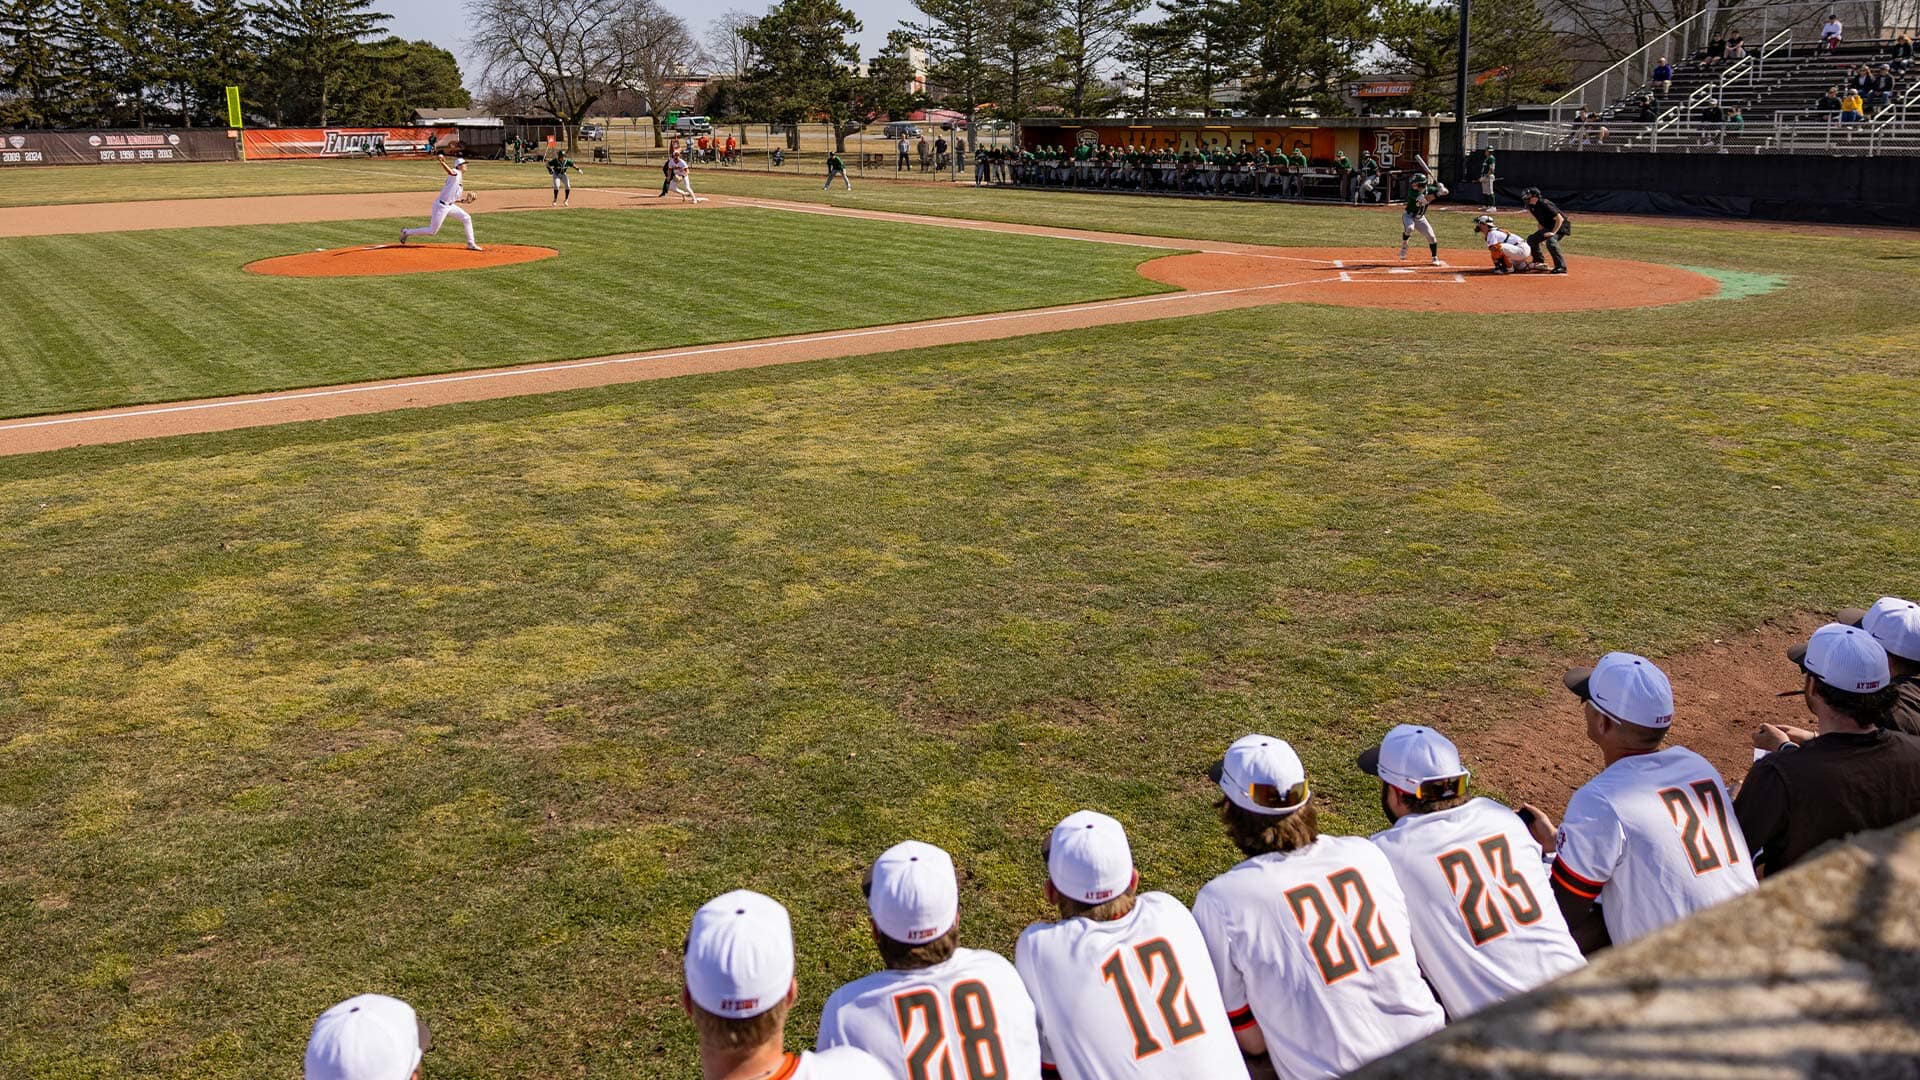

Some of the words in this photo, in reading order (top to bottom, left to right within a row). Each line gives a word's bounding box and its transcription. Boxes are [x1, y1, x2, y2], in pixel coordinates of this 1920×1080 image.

[100, 150, 116, 160] 1972
[1657, 778, 1740, 876] 27
[1283, 867, 1400, 985] 22
[1436, 833, 1544, 946] 23
[893, 978, 1009, 1080] 28
[1101, 936, 1206, 1061] 12
